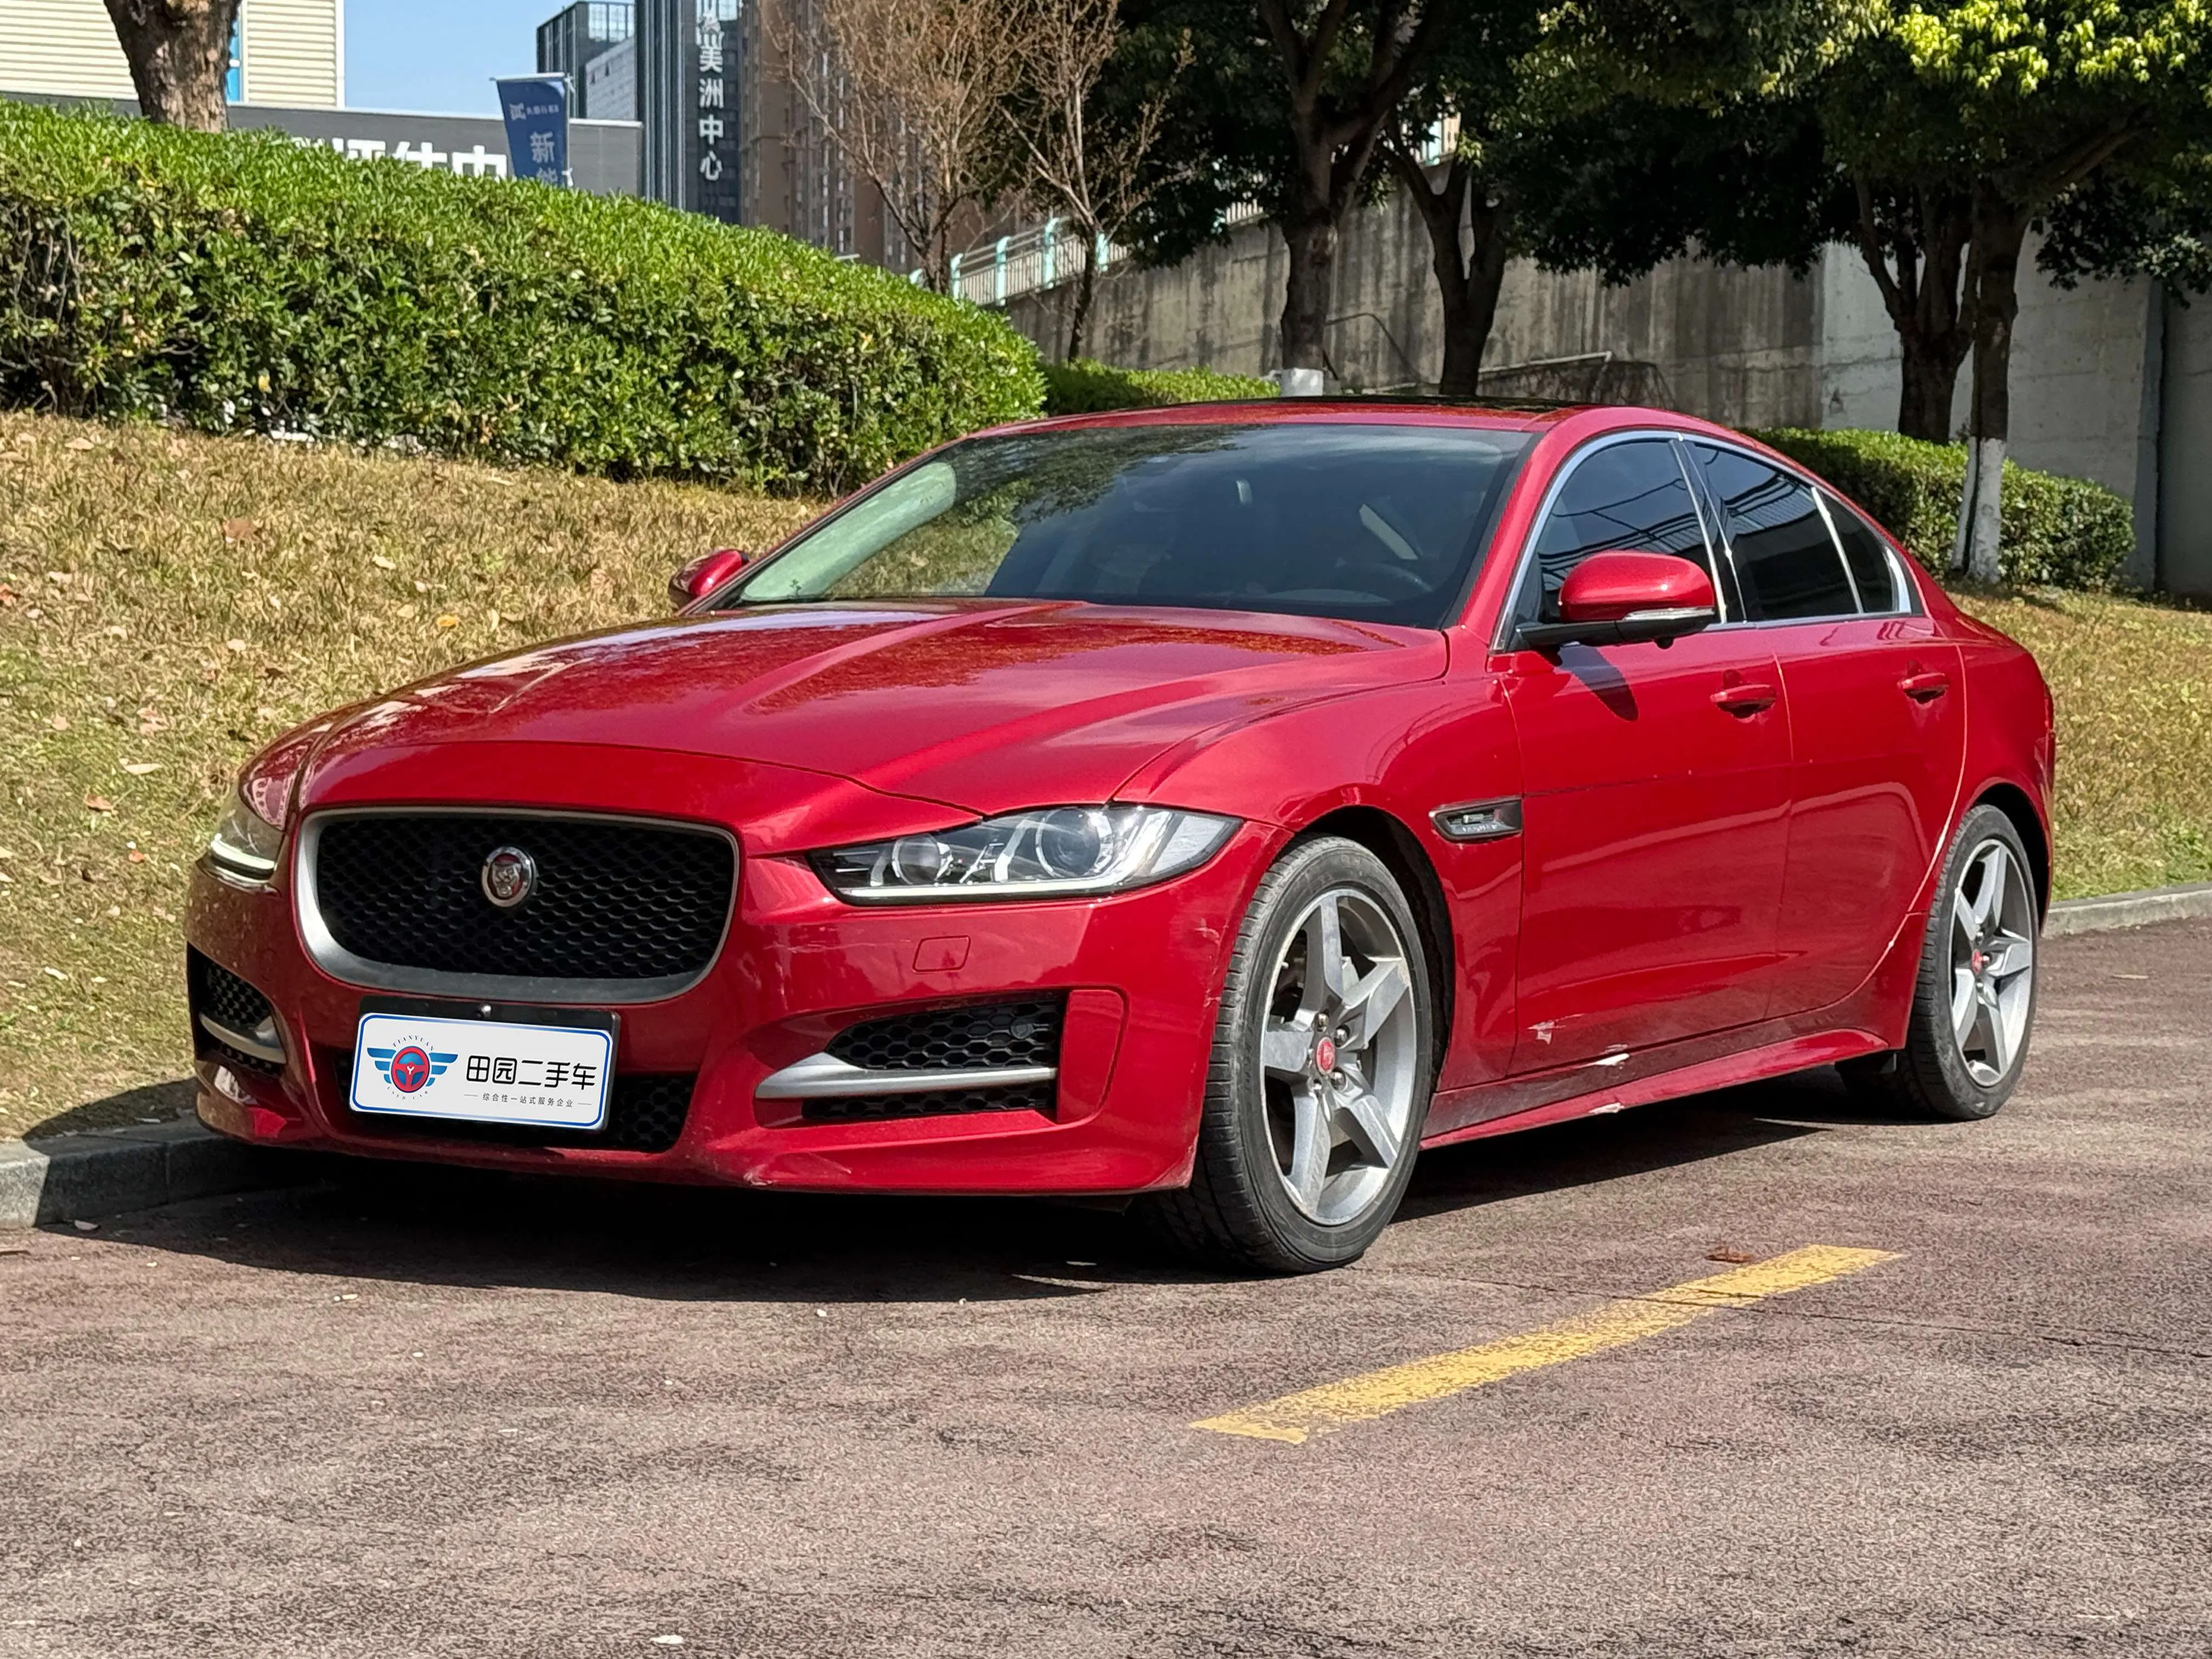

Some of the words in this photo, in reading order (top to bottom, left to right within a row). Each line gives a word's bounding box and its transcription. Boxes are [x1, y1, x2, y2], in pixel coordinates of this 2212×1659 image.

[466, 1055, 597, 1090] 田园二手车
[482, 1092, 573, 1108] 综合性一站式服务企业
